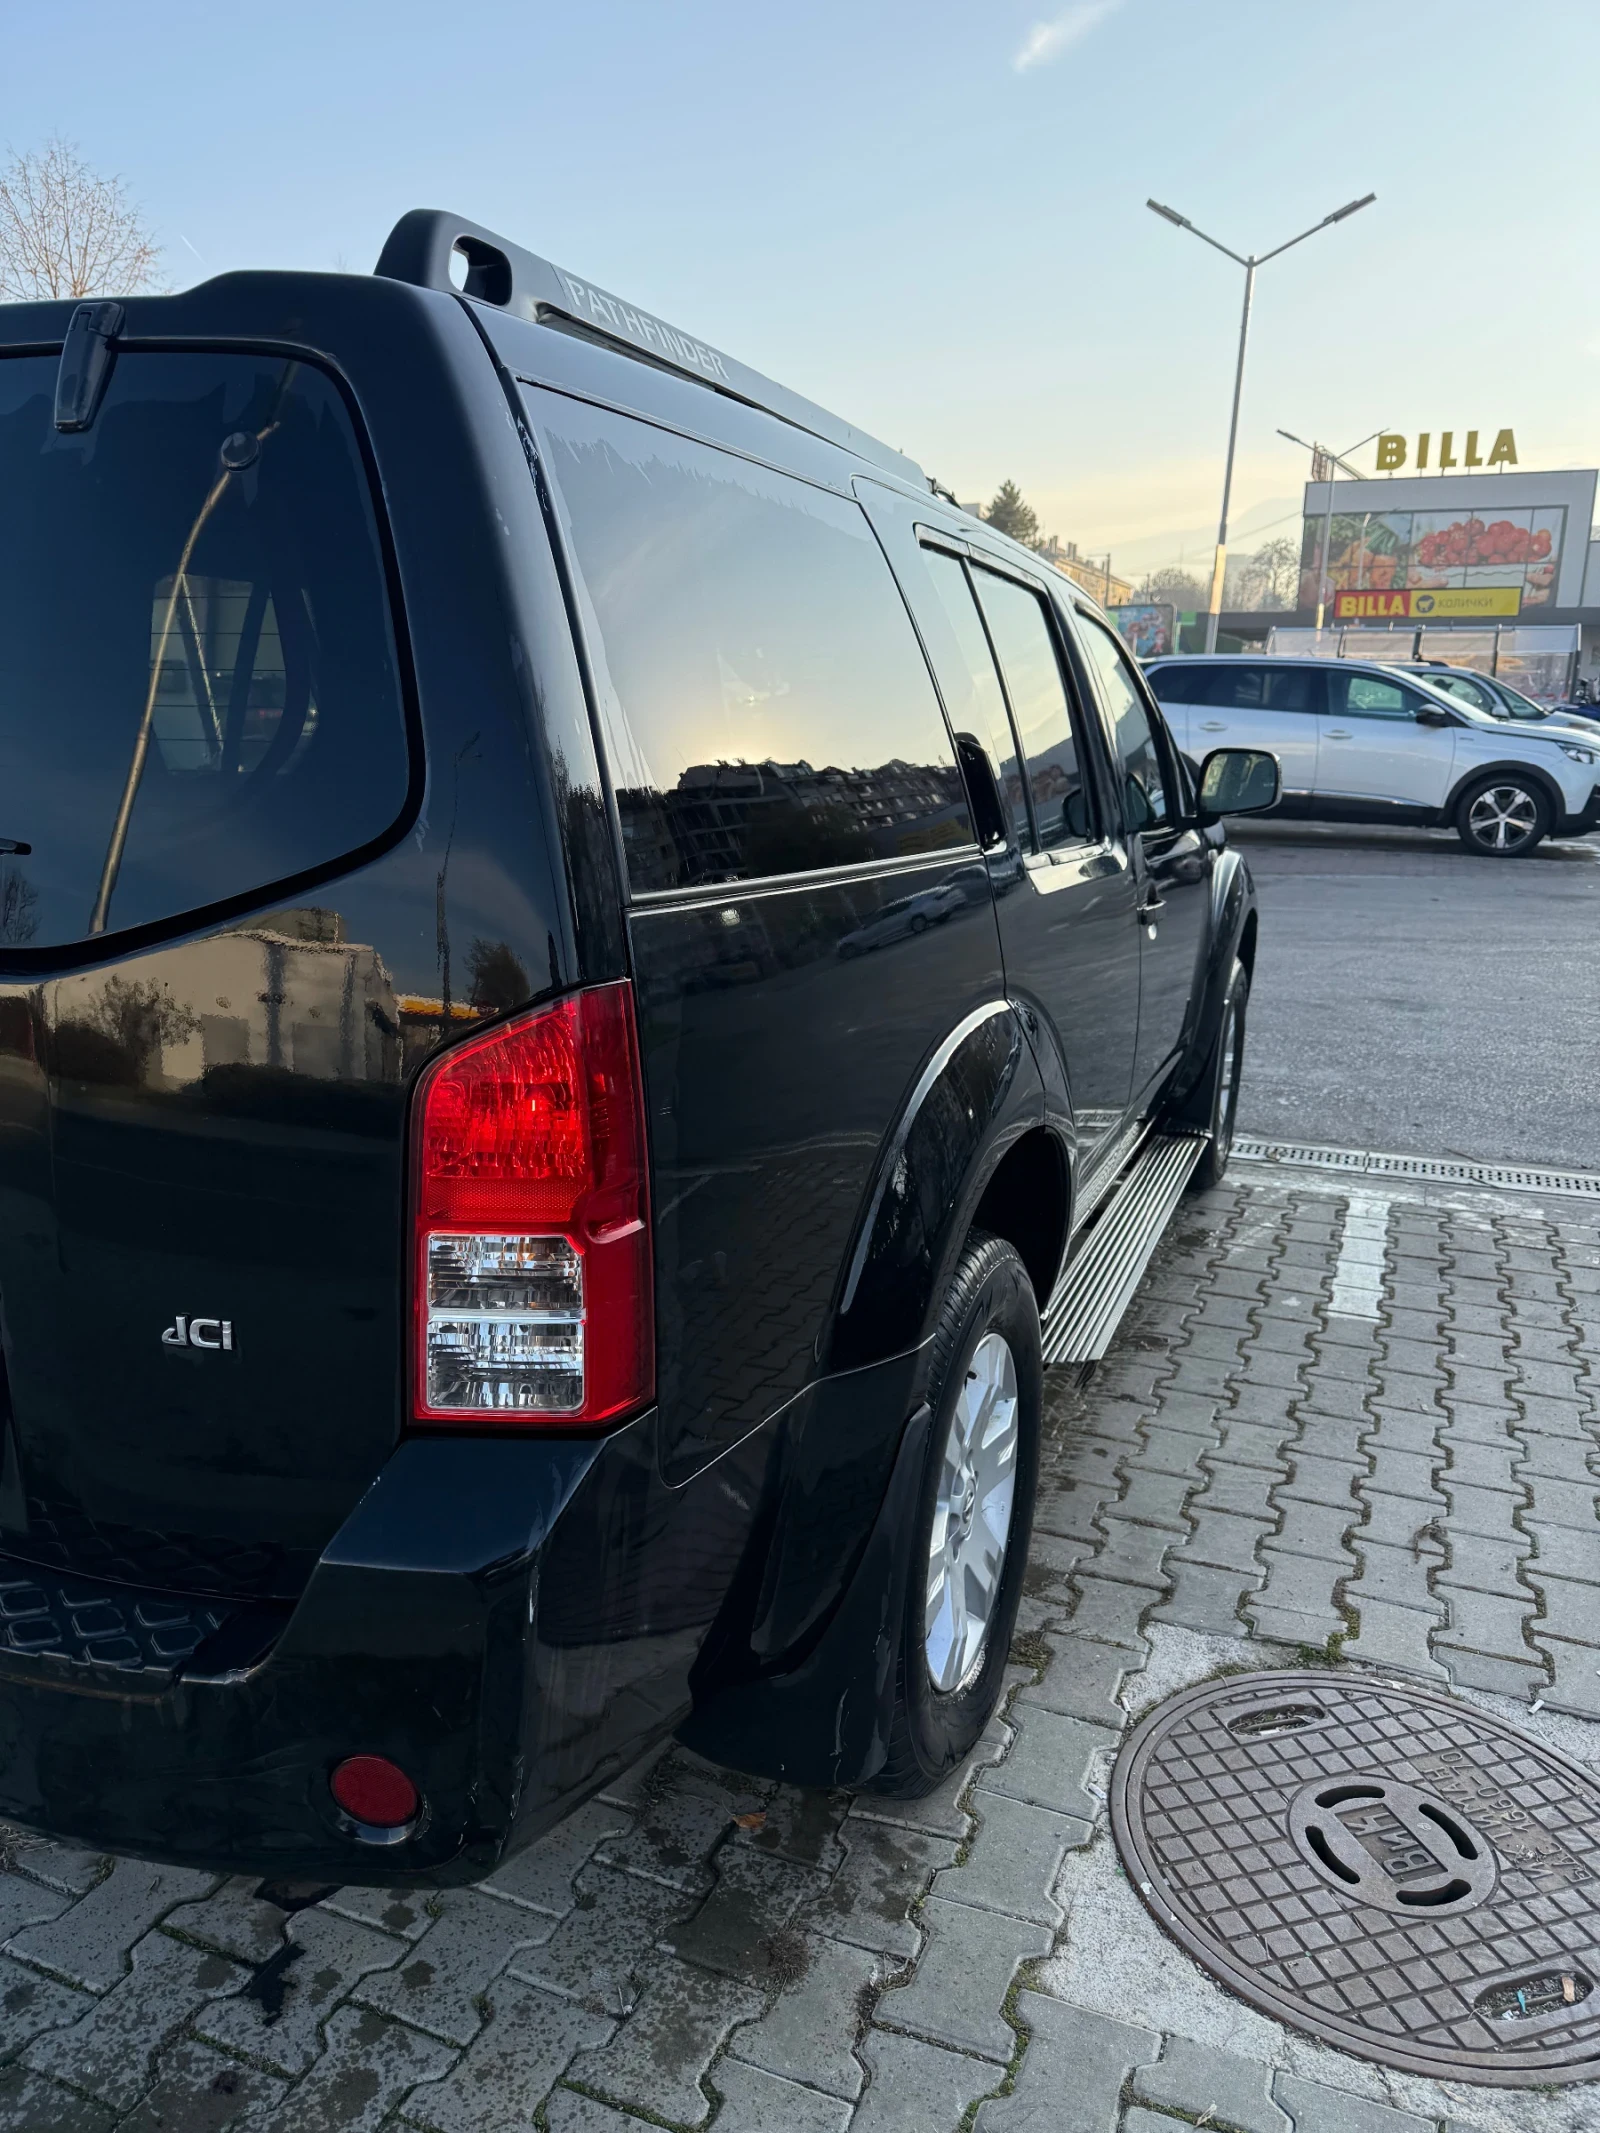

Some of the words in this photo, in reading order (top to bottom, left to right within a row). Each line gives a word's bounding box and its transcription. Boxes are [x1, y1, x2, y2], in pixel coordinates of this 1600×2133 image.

[565, 276, 730, 380] PATHFINDER
[1376, 428, 1518, 471] BILLA
[1339, 595, 1405, 617] BILLA
[161, 1316, 232, 1350] dCi
